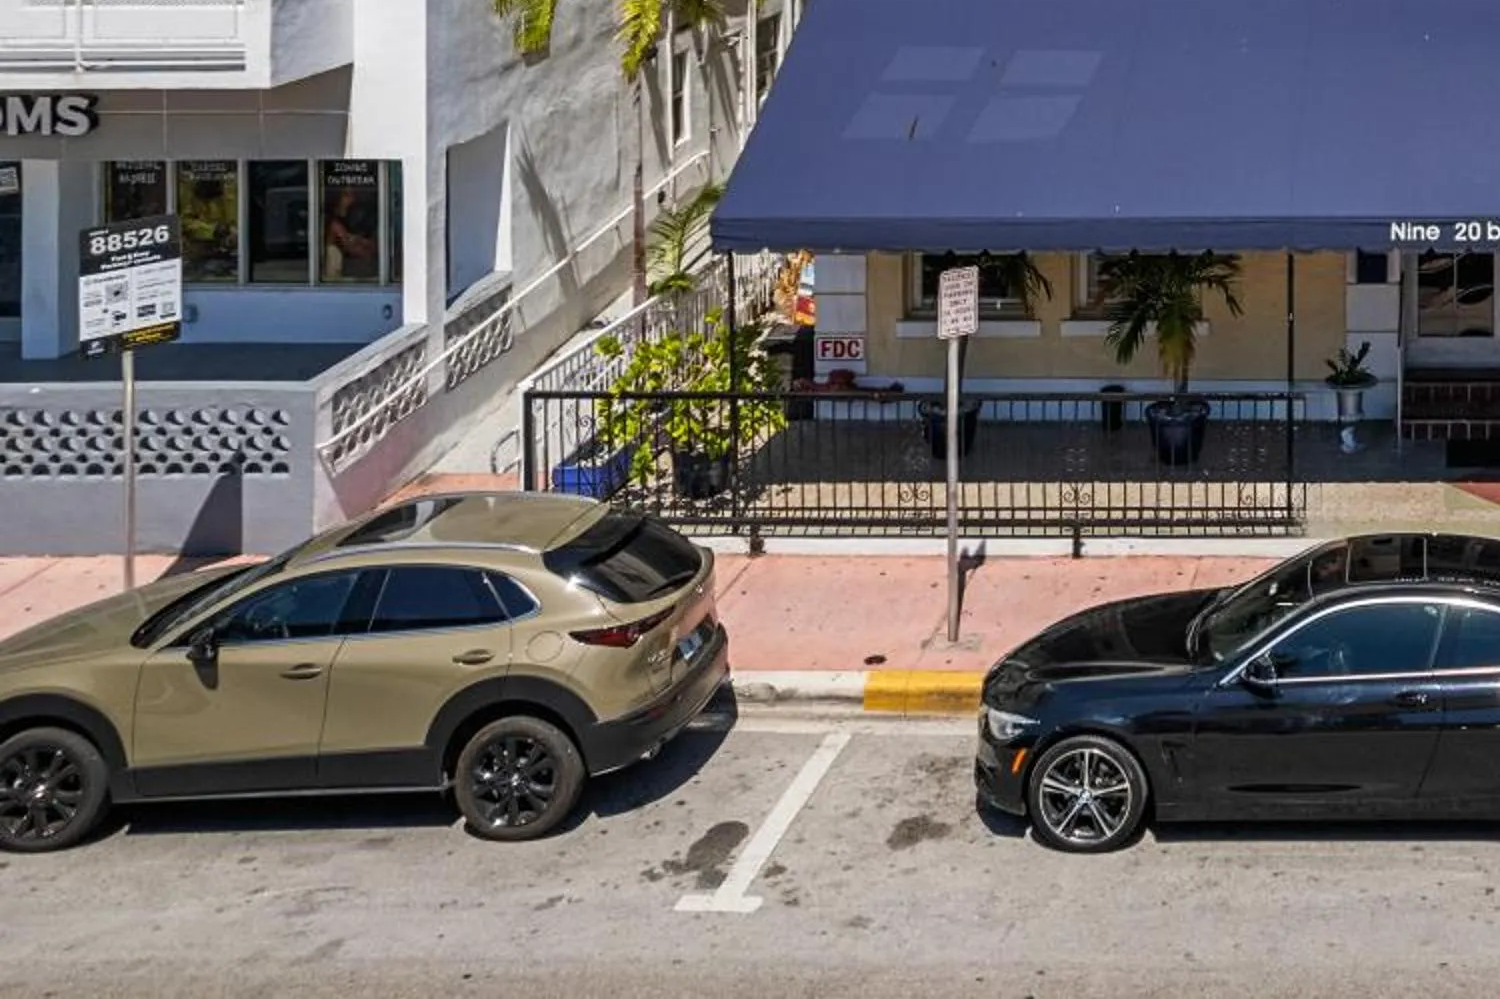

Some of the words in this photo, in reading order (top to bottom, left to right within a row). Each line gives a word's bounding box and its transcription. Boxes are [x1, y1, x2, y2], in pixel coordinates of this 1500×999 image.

[0, 96, 90, 137] MS
[90, 225, 169, 255] 88526
[1391, 221, 1440, 241] Nine
[1455, 221, 1480, 241] 20
[821, 340, 860, 358] FDC
